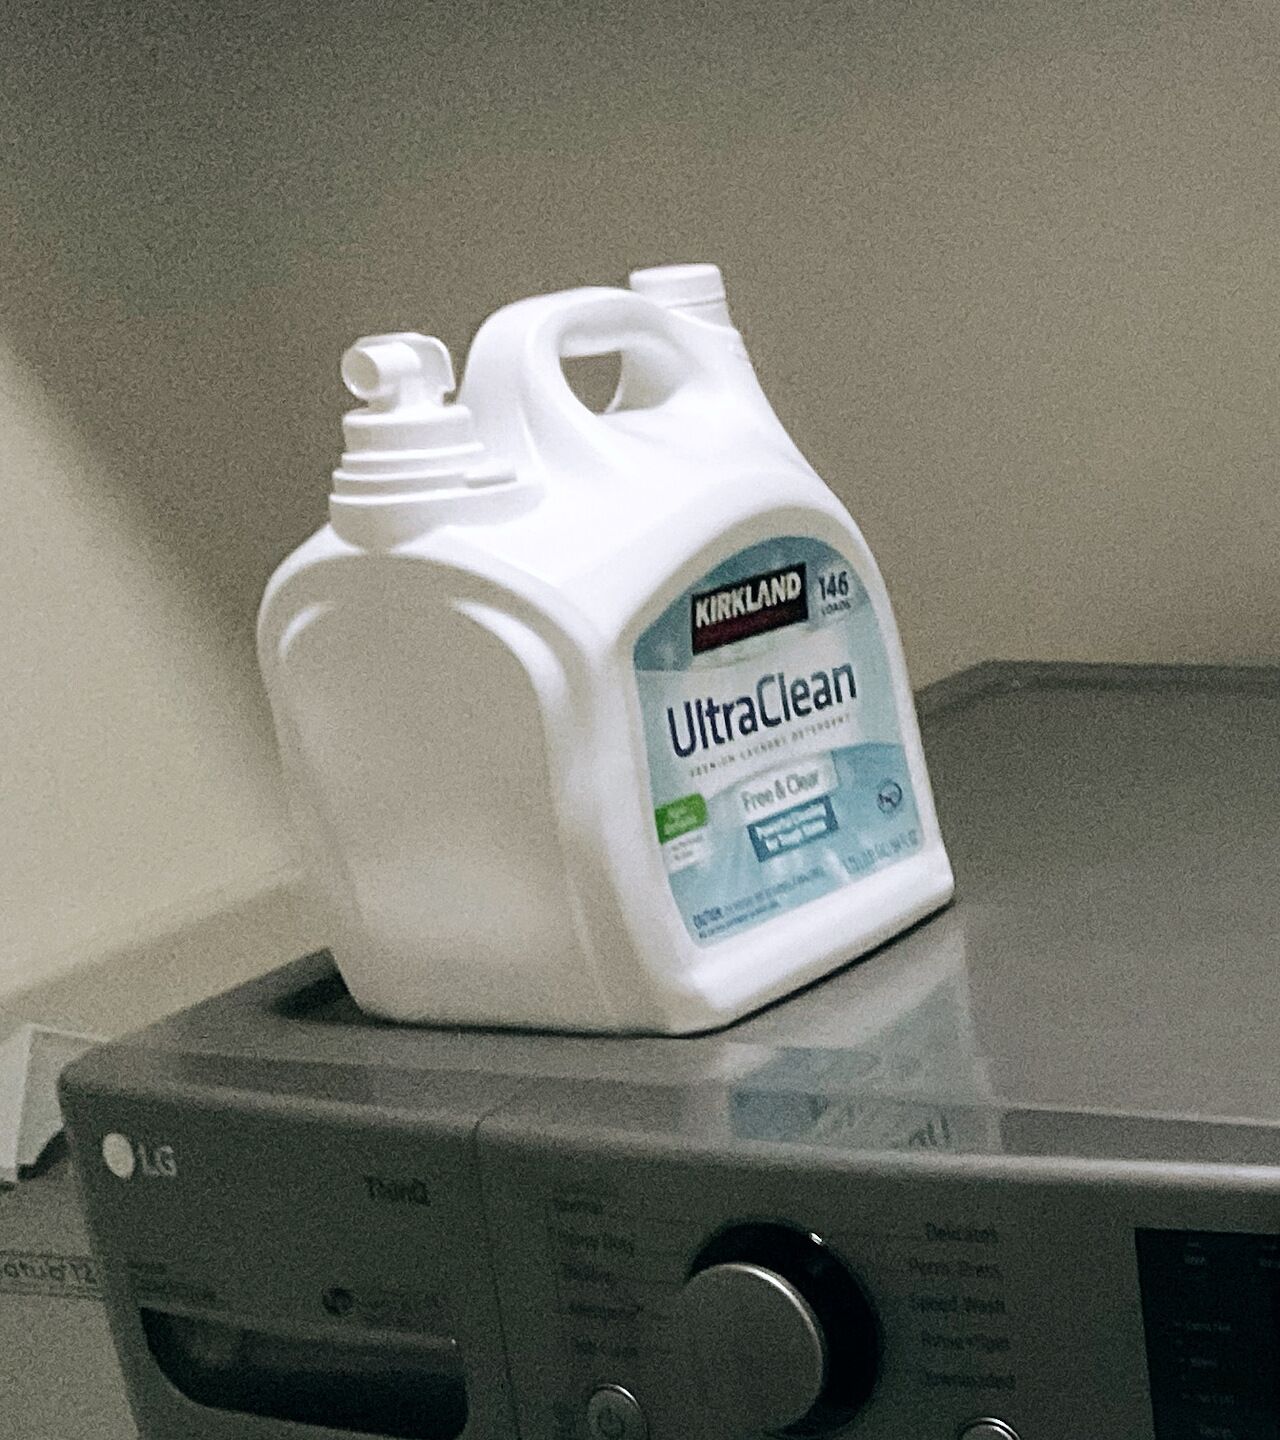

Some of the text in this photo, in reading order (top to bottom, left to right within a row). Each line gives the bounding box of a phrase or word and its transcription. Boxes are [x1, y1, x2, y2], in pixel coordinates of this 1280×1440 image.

[695, 571, 802, 628] KIRKLAND
[818, 570, 849, 602] 146
[666, 662, 857, 759] UltraClean
[742, 788, 773, 812] Free
[787, 768, 821, 796] Clear
[136, 1144, 178, 1178] LG
